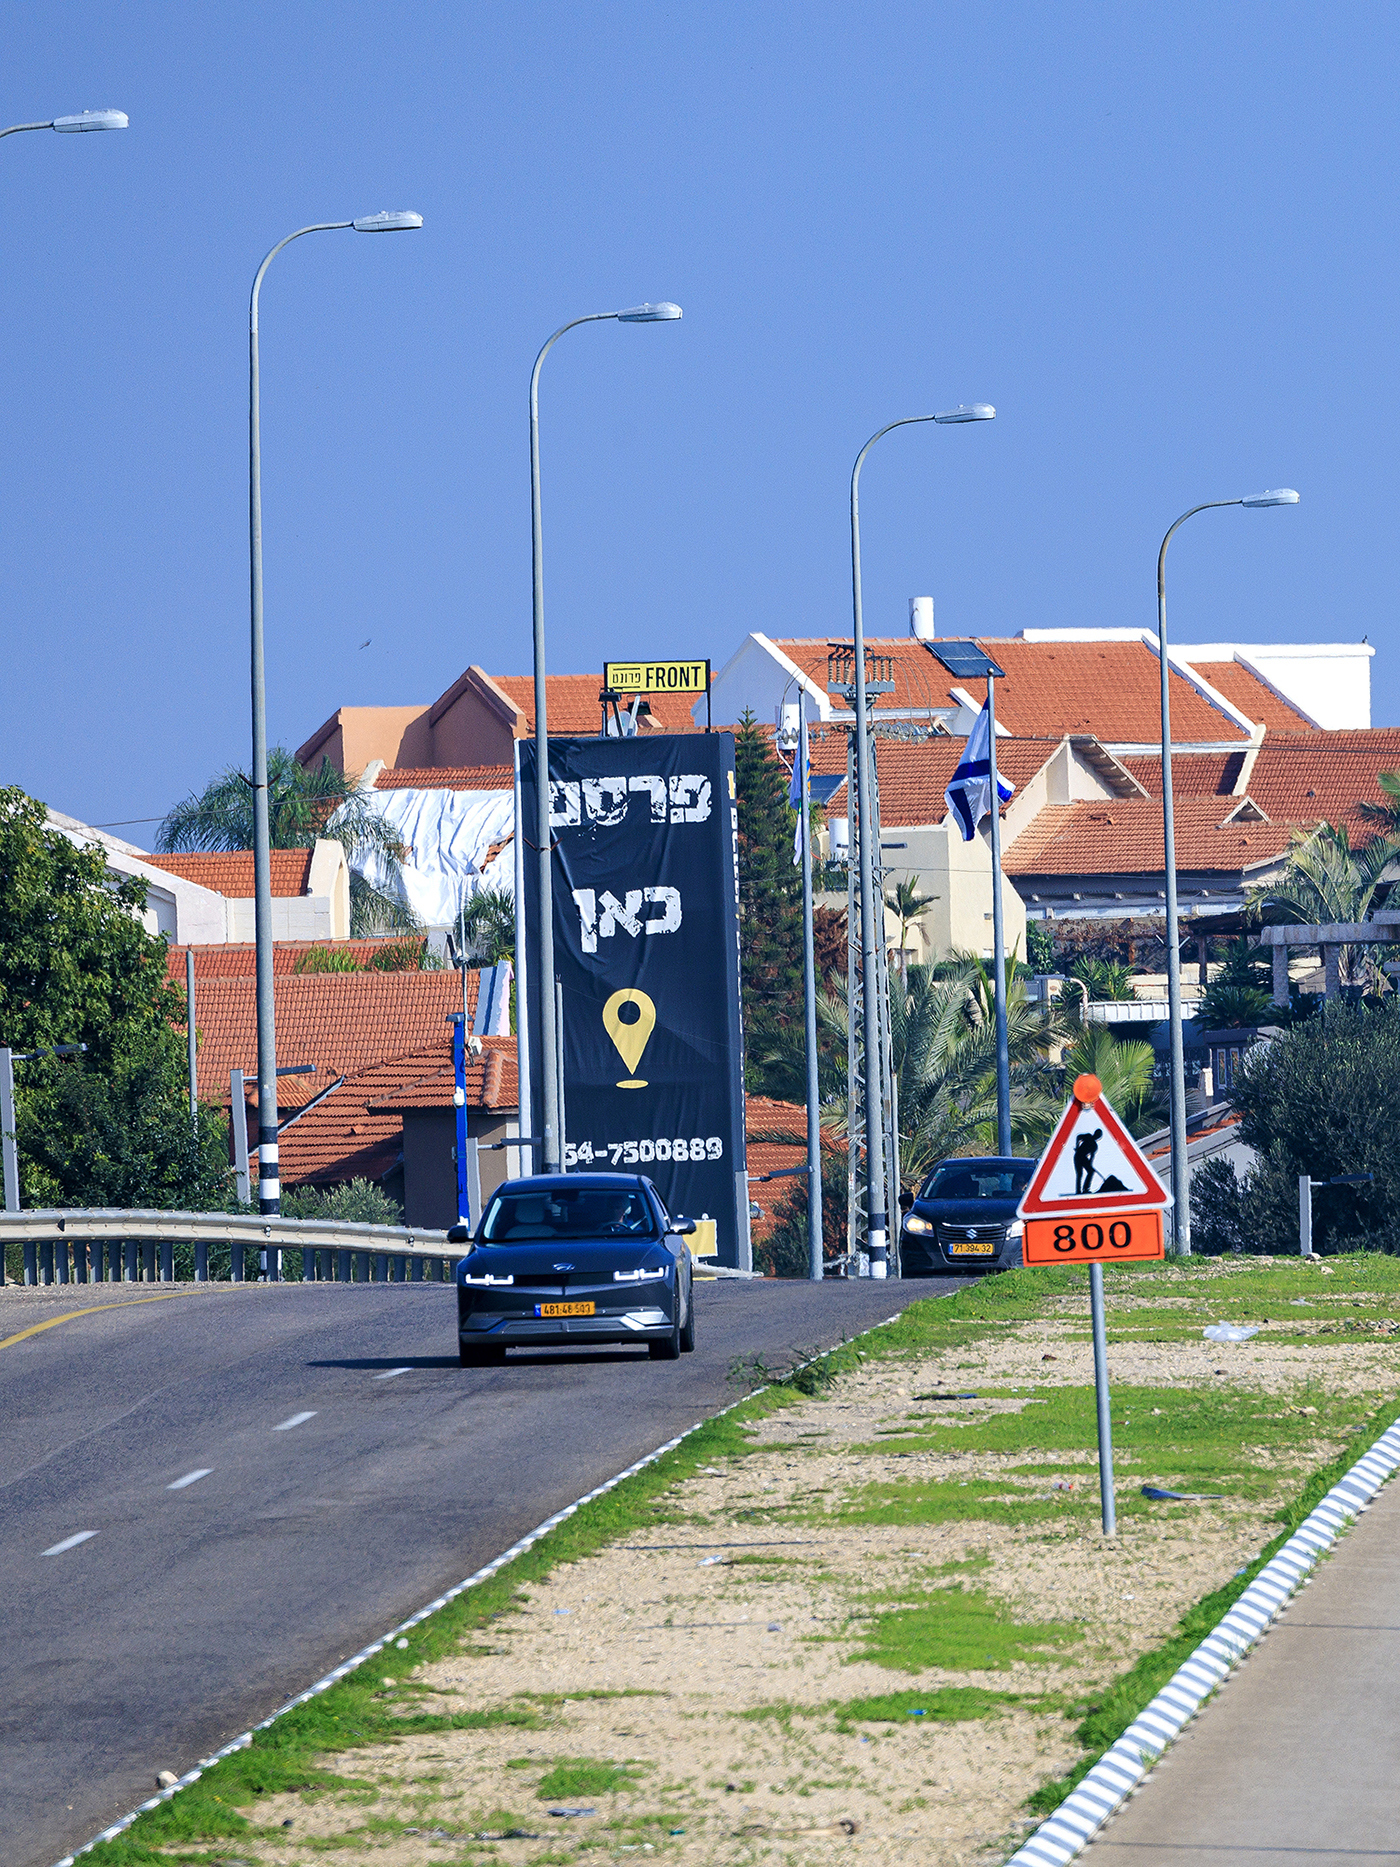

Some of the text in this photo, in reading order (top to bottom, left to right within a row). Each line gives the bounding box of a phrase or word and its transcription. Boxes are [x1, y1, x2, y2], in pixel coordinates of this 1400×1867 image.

[612, 672, 640, 683] פרונט
[645, 666, 701, 688] FRONT
[548, 774, 712, 827] פרסם
[572, 886, 682, 953] כאן
[565, 1136, 723, 1167] 54-7500889
[1053, 1221, 1131, 1252] 800
